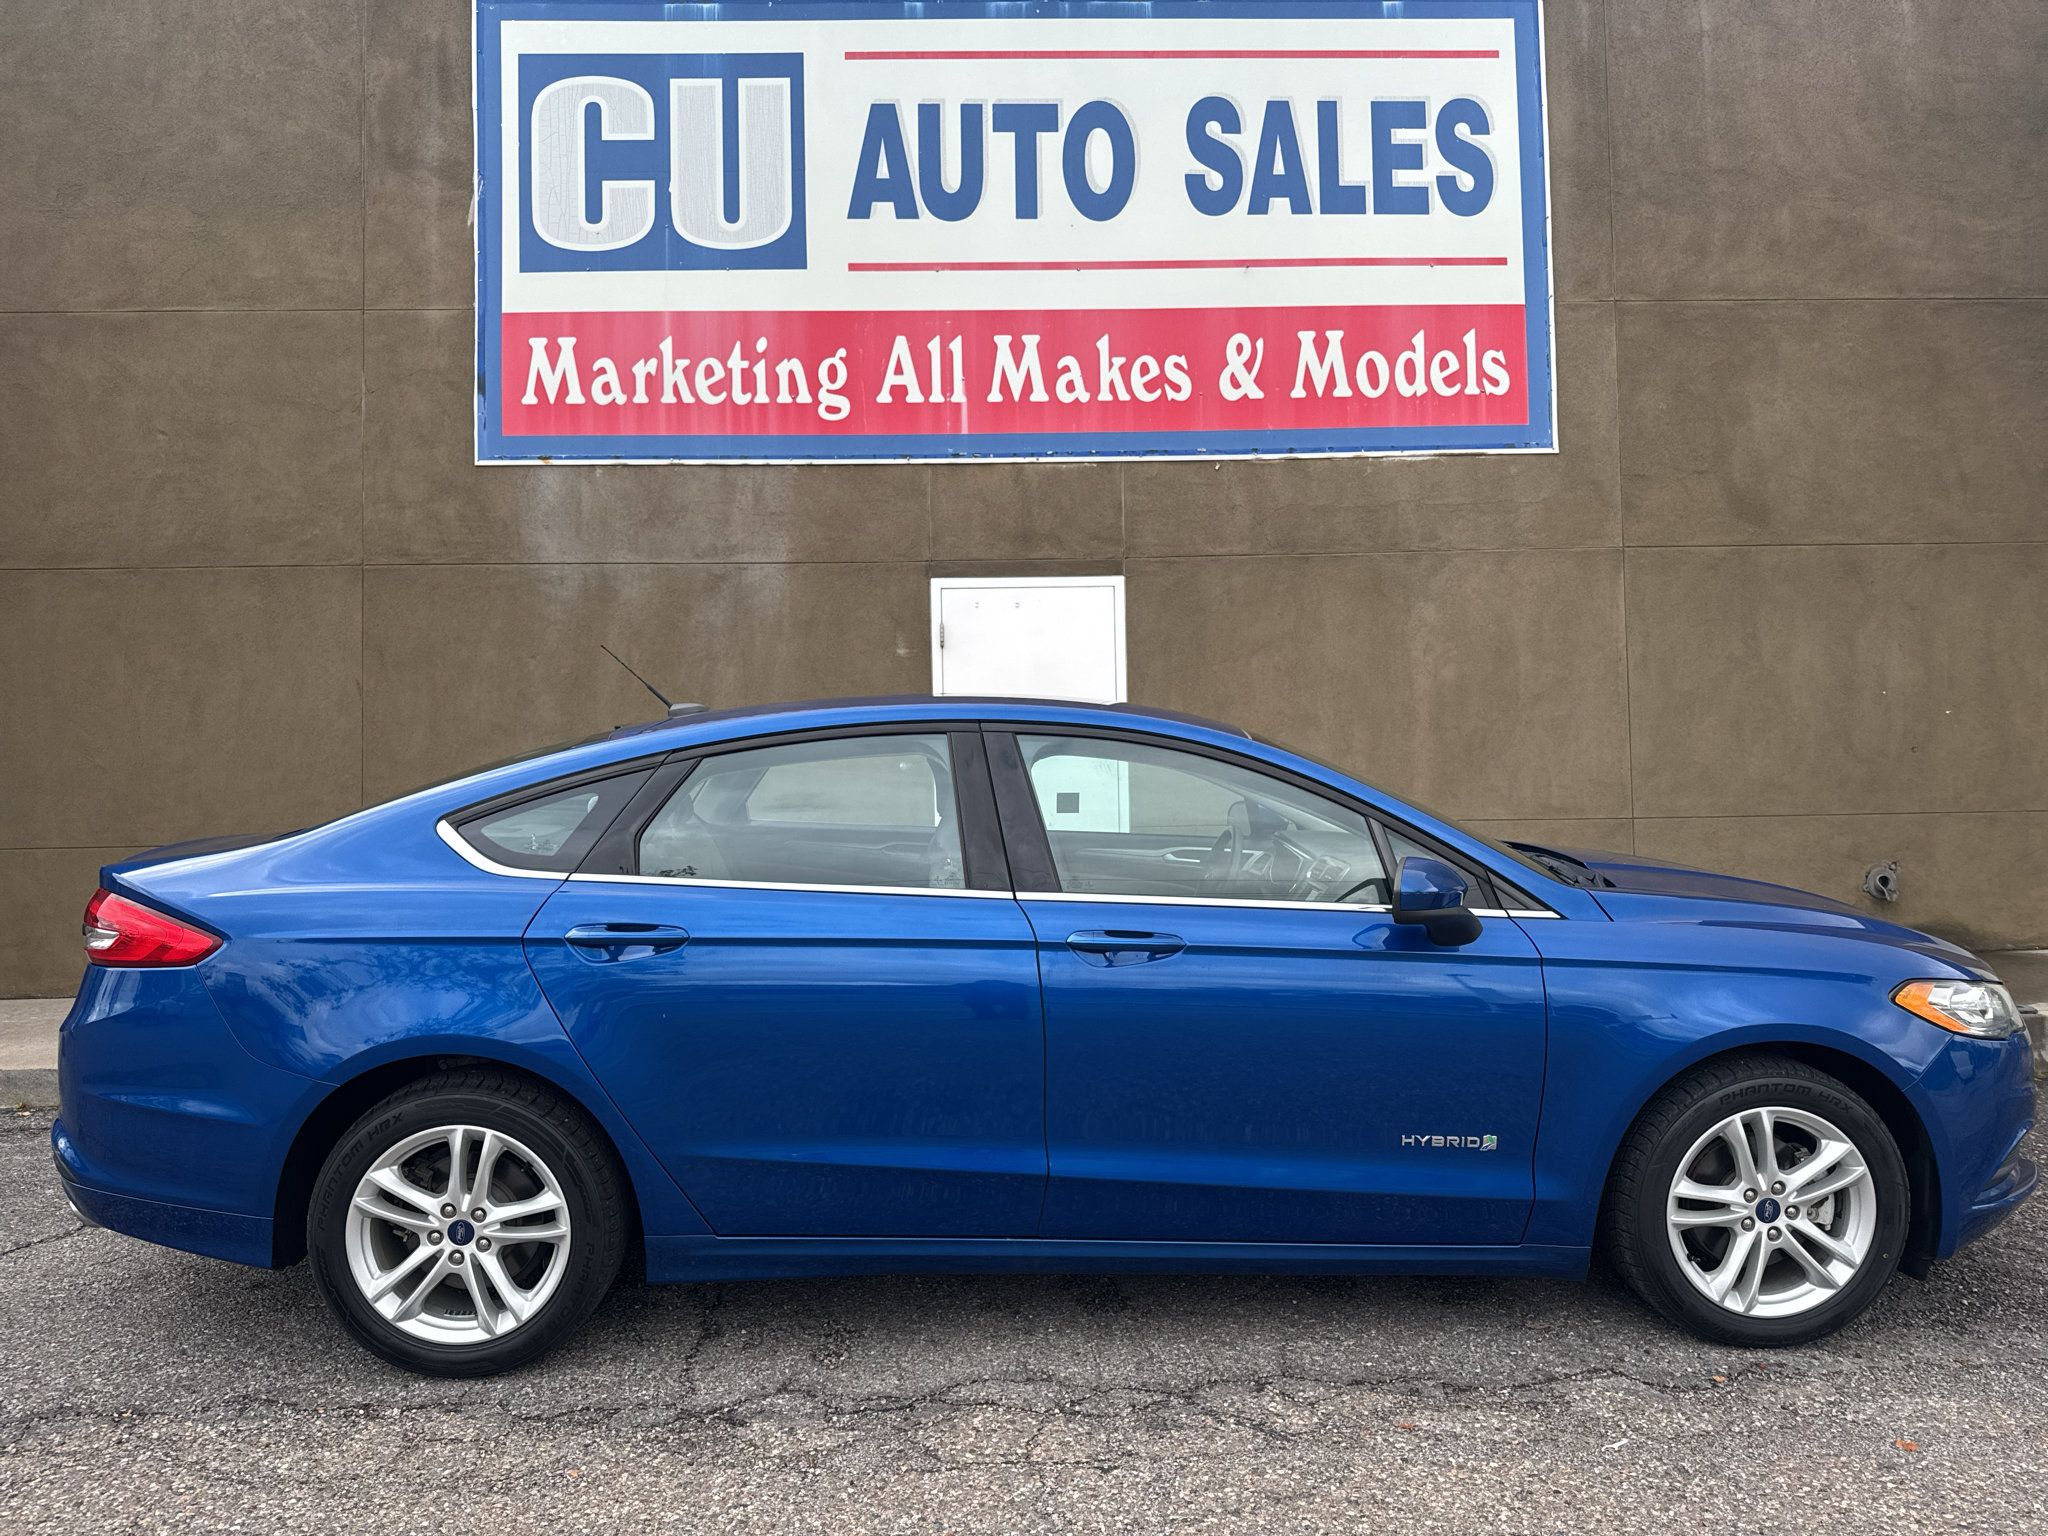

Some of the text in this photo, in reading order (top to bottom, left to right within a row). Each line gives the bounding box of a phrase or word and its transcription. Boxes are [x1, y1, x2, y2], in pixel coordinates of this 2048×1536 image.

[530, 75, 794, 252] CU
[846, 92, 1498, 222] AUTO SALES
[520, 328, 1511, 421] Marketing All Makes & Models
[1401, 1134, 1481, 1148] HYBRID
[1719, 1082, 1855, 1114] PHANTOM HRX
[316, 1111, 403, 1231] PHANTOM HRX
